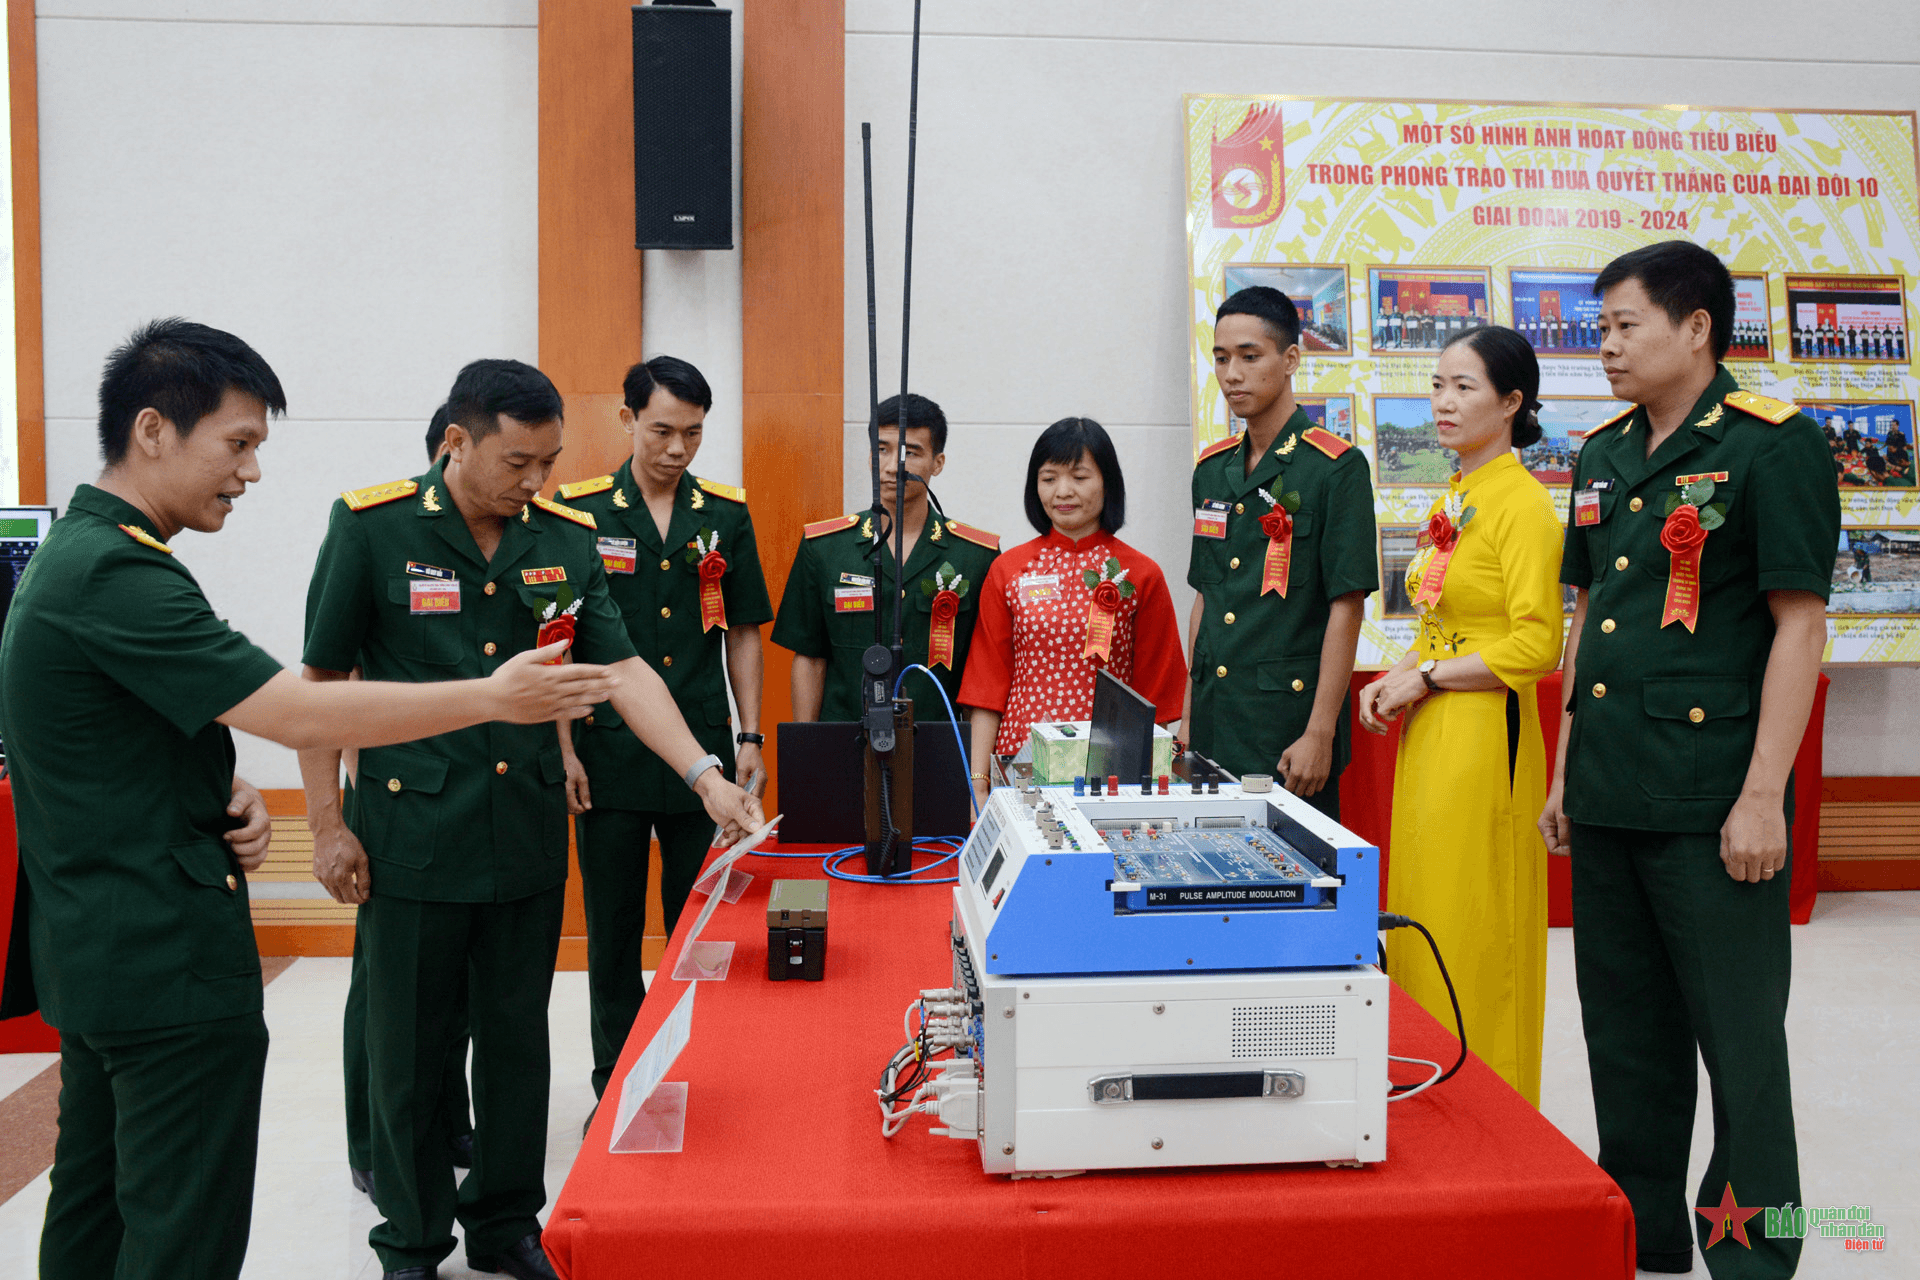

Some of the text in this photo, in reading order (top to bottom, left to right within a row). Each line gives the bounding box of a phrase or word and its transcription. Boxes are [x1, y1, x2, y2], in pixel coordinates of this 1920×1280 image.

[1403, 118, 1777, 154] MỘT SỐ HÌNH ẢNH HOẠT ĐỘNG TIÊU BIỂU
[1307, 164, 1879, 200] TRONG PHONG TRÀO THI ĐUA QUYẾT THẮNG CỦA ĐẠI ĐỘI 10
[1473, 206, 1511, 226] GIAI
[1518, 207, 1569, 231] ĐOẠN
[1575, 208, 1621, 229] 2019
[1640, 210, 1689, 230] 2024
[1150, 890, 1296, 900] M-31 PULSE AMPLITUDE MODULATION
